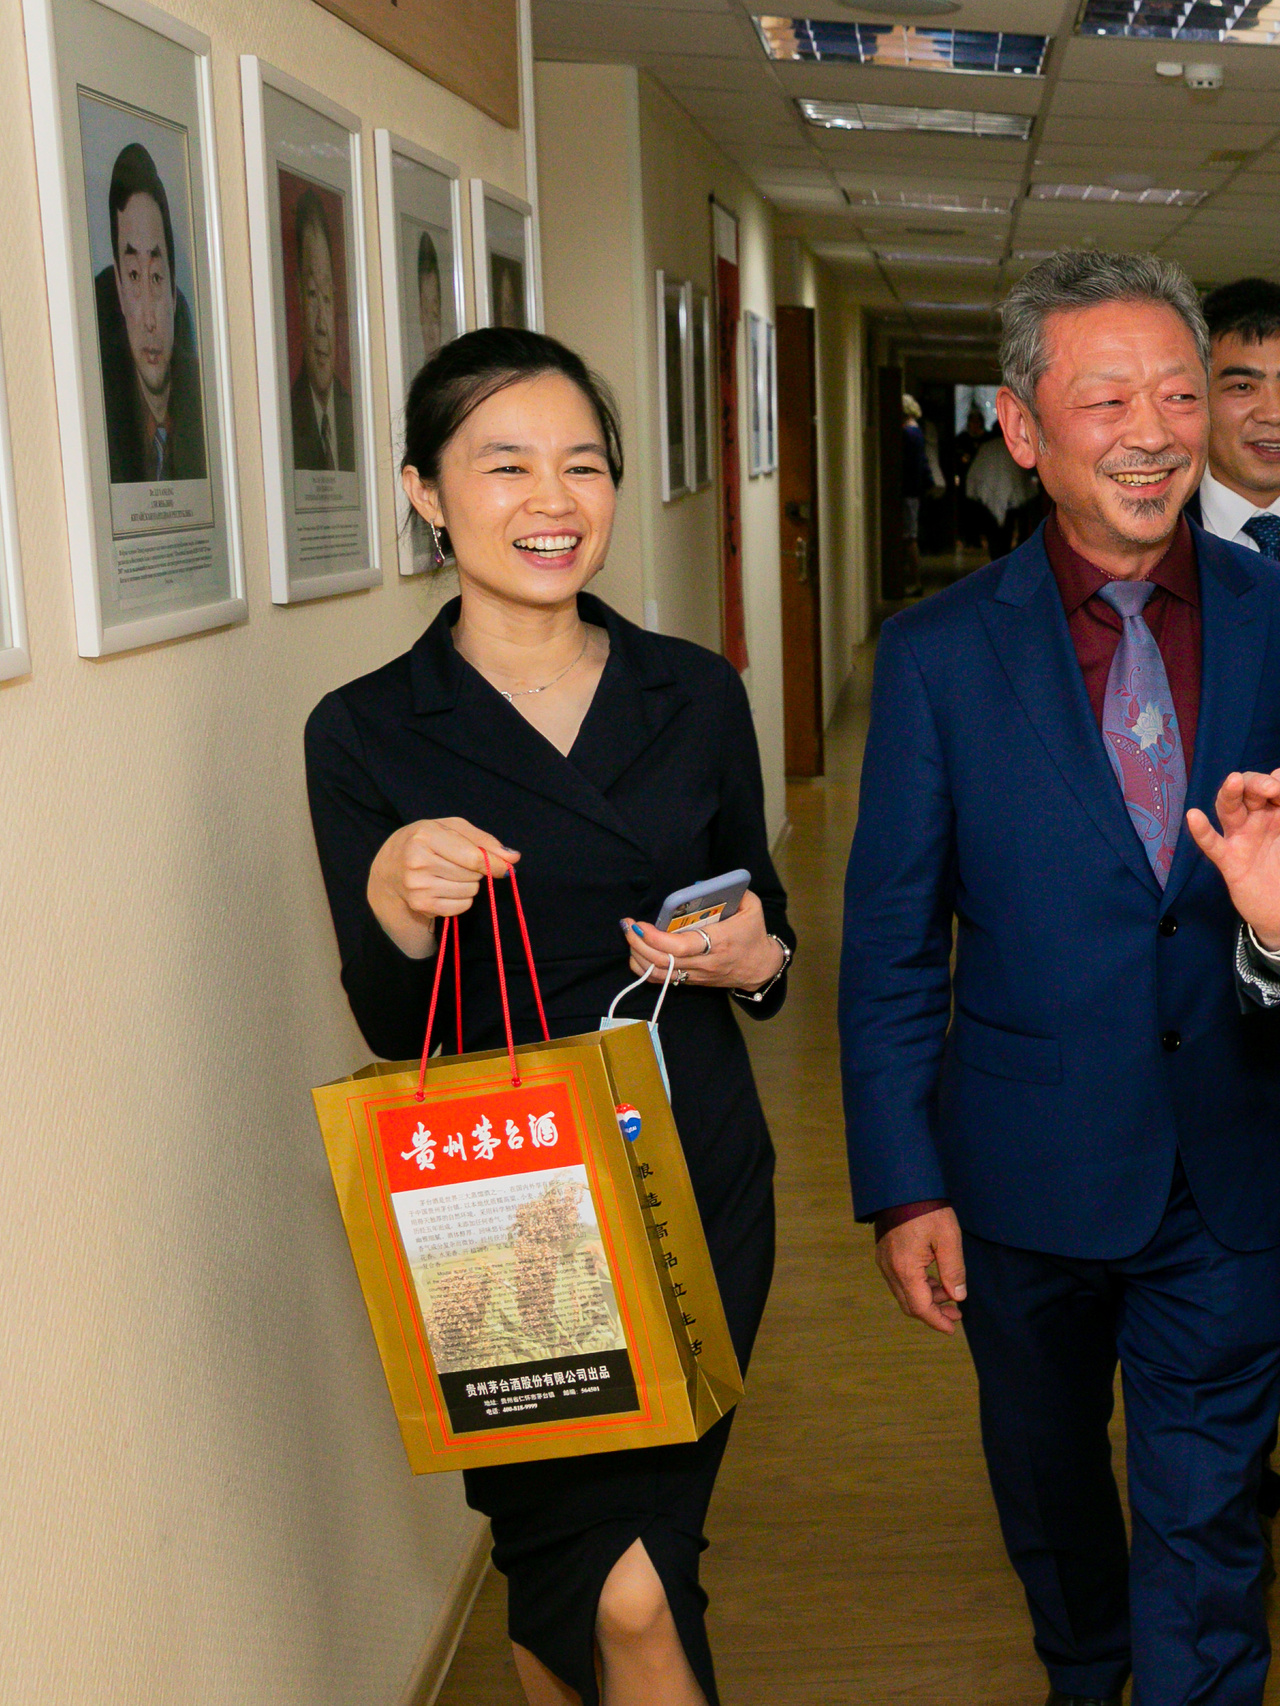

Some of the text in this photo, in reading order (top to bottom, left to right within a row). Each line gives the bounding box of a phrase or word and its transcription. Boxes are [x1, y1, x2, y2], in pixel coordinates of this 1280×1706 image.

[400, 1111, 558, 1171] 贵州茅台酒
[465, 1365, 611, 1398] 贵州茅台酒股份有限公司出品
